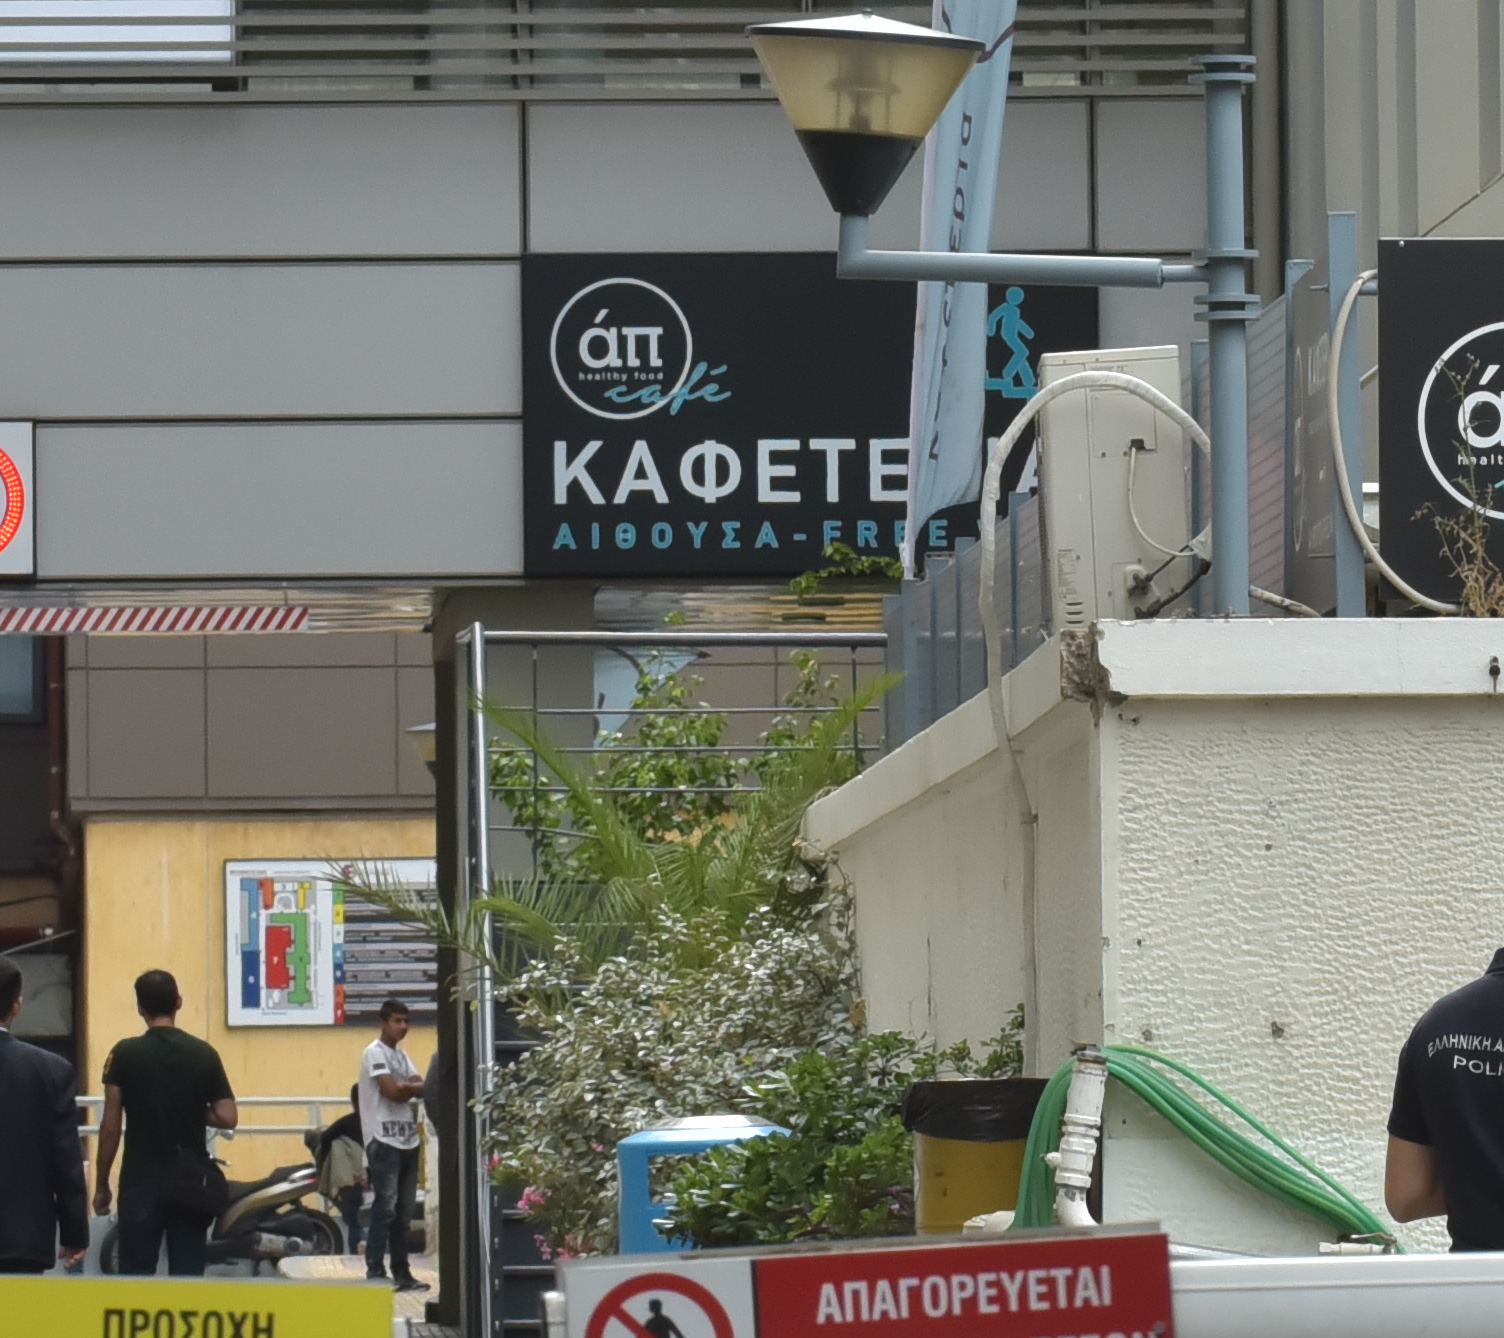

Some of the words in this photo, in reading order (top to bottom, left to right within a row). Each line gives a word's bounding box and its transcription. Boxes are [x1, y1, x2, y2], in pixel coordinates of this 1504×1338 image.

[578, 308, 663, 367] άπ
[578, 370, 628, 382] healthy
[634, 370, 664, 381] food
[603, 361, 732, 415] café
[553, 438, 1039, 505] ΚΑΦΕΤΕ
[1427, 1033, 1492, 1058] ΕΛΛΗΝΙΚΗ
[816, 1264, 1112, 1325] ΑΠΑΓΟΡΕΥΕΤΑΙ
